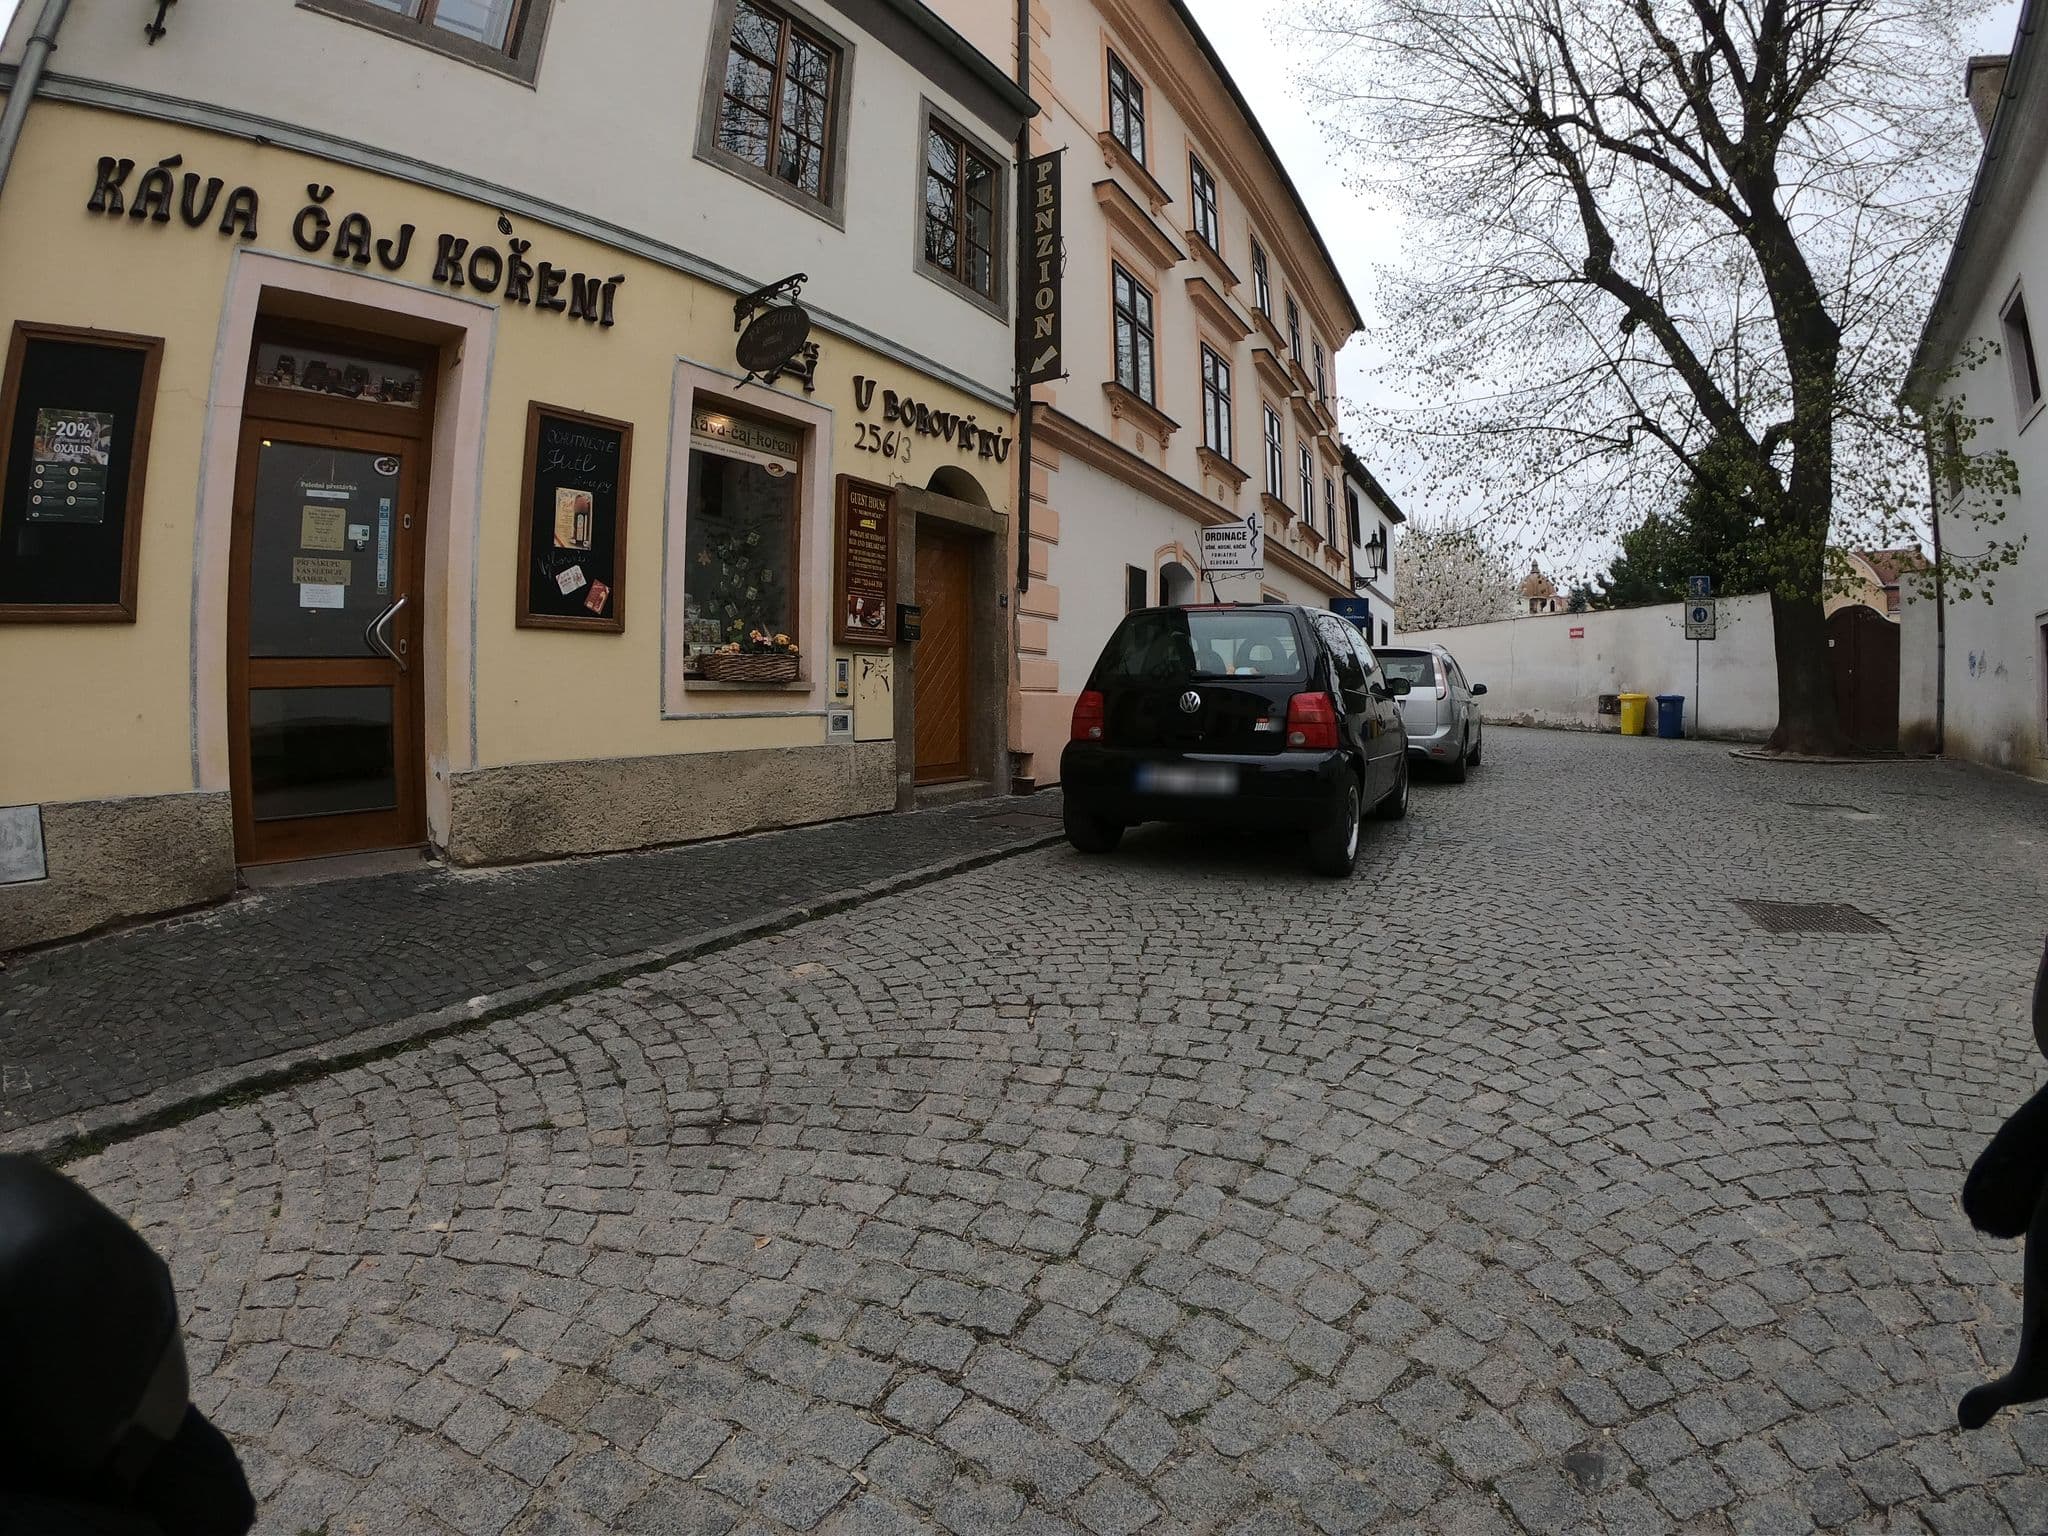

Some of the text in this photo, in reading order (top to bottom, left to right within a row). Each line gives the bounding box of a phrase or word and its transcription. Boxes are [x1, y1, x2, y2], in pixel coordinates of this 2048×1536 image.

[87, 154, 626, 328] KÁVA ČAJ KOŘENÍ
[1034, 160, 1055, 339] PENZION
[50, 421, 93, 438] -20%
[852, 375, 1013, 464] U BOROVIČKŮ
[53, 443, 92, 455] OXALIS
[854, 421, 912, 463] 256/3
[850, 492, 887, 511] GUEST HOUSE
[1205, 531, 1247, 542] ORDINACE
